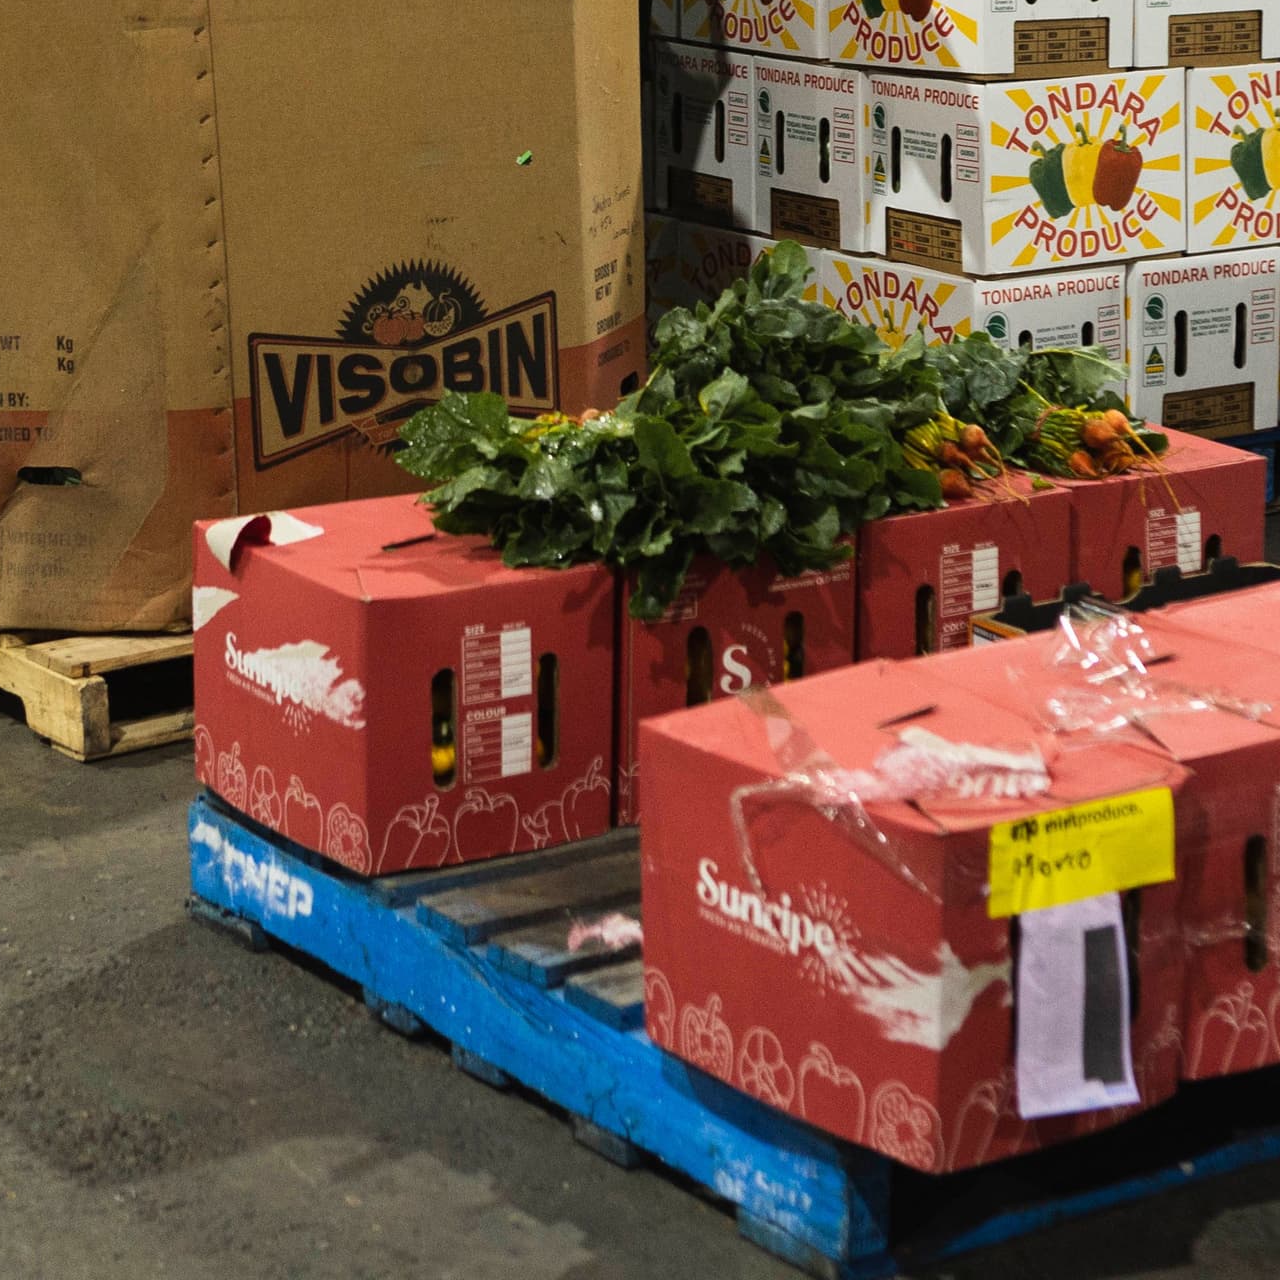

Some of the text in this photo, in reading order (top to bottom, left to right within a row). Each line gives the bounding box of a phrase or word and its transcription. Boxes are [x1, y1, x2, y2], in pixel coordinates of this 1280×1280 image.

[844, 0, 954, 63] PRODUCE
[701, 58, 748, 79] PRODUCE
[756, 66, 854, 94] TONDARA PRODUCE
[872, 80, 979, 110] TONDARA PRODUCE
[1006, 83, 1160, 153] TONDARA
[1015, 192, 1159, 258] PRODUCE
[691, 242, 752, 292] TOND
[1142, 260, 1276, 287] TONDARA PRODUCE
[982, 275, 1120, 305] TONDARA PRODUCE
[837, 272, 955, 344] TONDARA
[0, 336, 21, 351] WT
[56, 335, 73, 353] Kg
[57, 357, 75, 374] Kg
[262, 312, 548, 439] VISOBIN
[8, 392, 30, 407] BY:
[1149, 508, 1166, 518] SIZE
[943, 544, 960, 554] SIZE
[464, 623, 485, 637] SIZE
[720, 644, 752, 694] S
[466, 706, 506, 721] COLOUR
[697, 857, 836, 957] Sunripe
